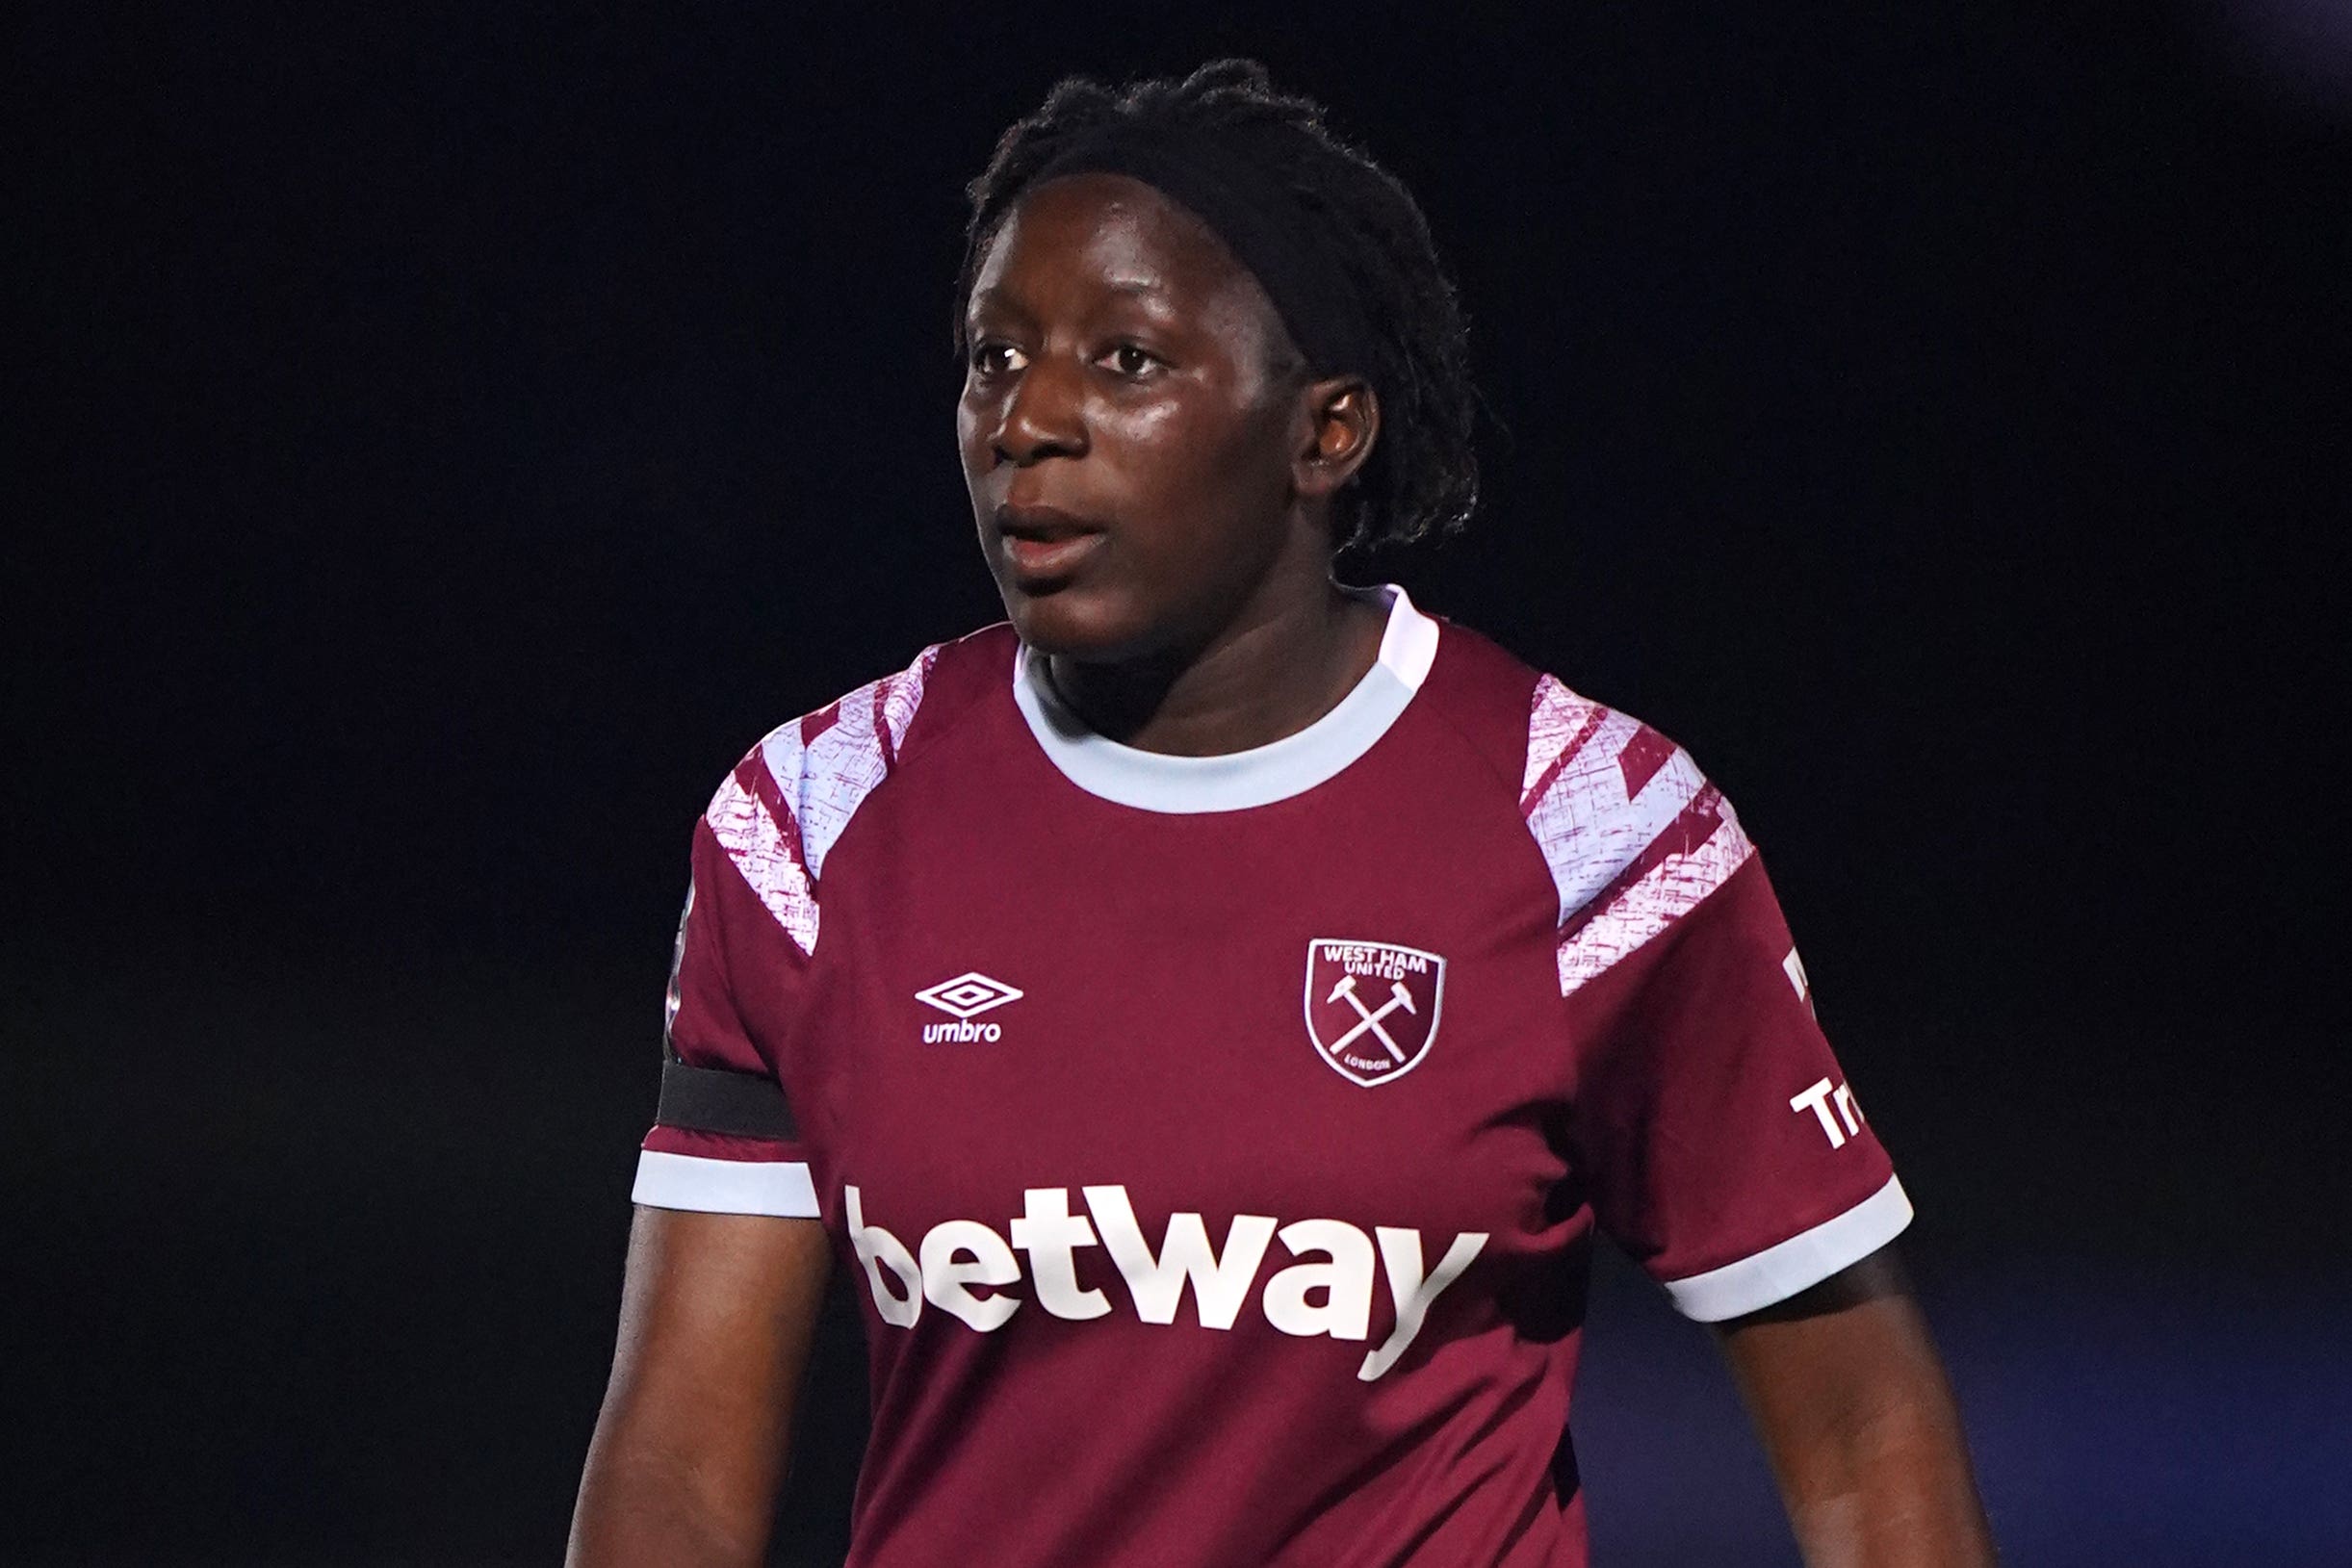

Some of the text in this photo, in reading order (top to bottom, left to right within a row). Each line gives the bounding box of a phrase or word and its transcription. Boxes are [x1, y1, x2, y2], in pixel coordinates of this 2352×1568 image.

[1324, 946, 1428, 974] WEST HAM
[1344, 962, 1405, 980] UNITED
[922, 1018, 1002, 1044] umbro
[1344, 1054, 1391, 1071] LONDON
[844, 1184, 1489, 1381] betway
